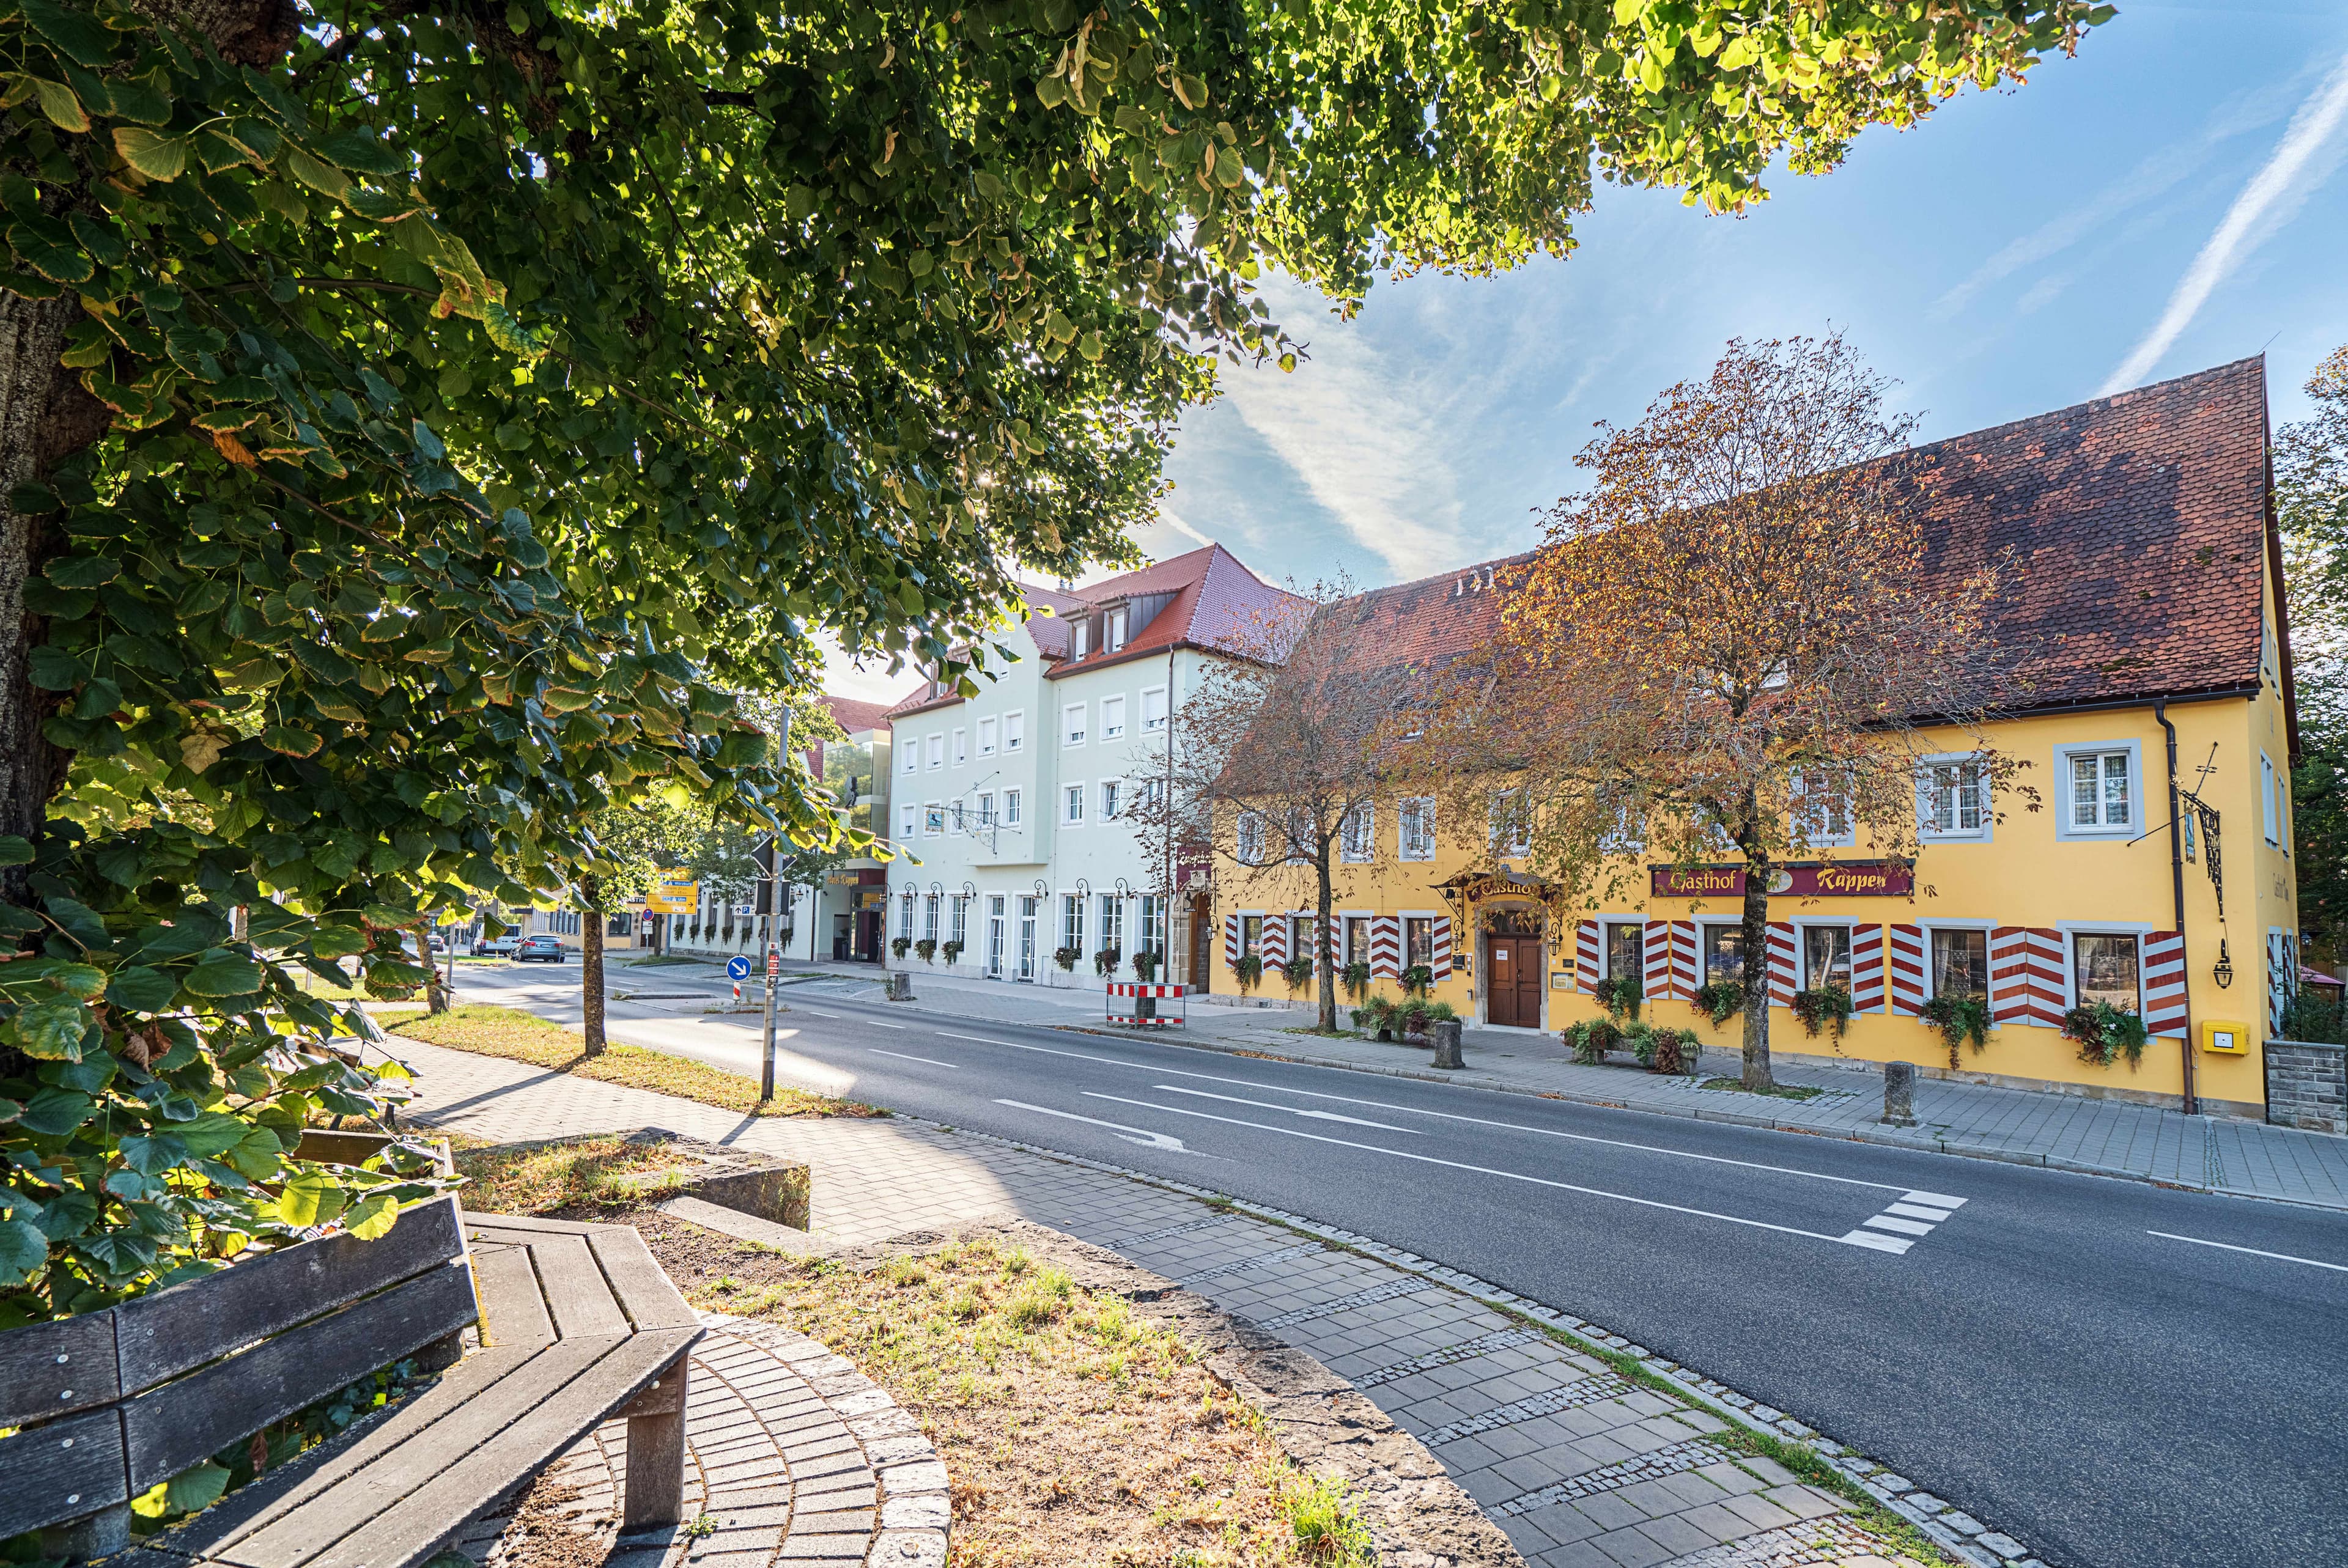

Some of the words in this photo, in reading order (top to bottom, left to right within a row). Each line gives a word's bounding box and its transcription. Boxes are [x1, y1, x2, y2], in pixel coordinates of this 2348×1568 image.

[1482, 881, 1531, 895] Gastho
[1670, 870, 1737, 893] Gasthof
[1817, 868, 1886, 891] Rappen
